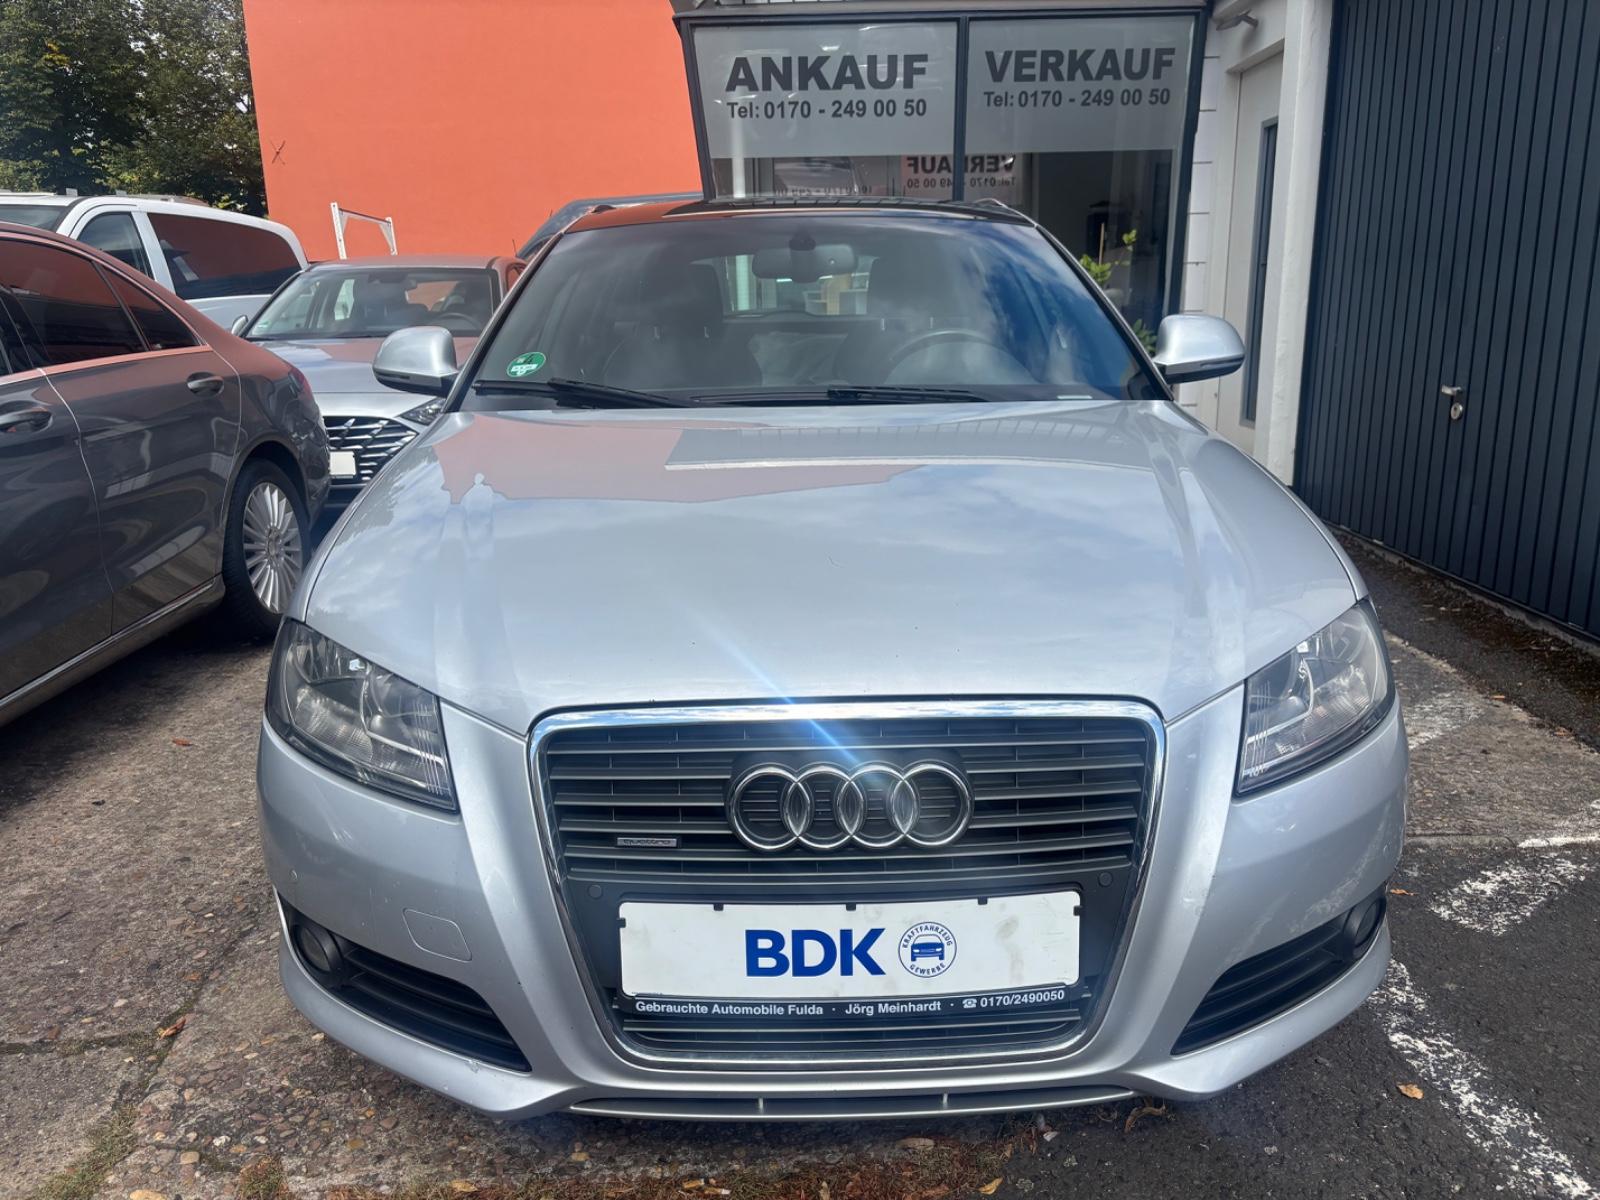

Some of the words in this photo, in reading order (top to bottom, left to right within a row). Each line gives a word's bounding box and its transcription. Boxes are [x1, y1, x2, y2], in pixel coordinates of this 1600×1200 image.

[725, 54, 929, 92] ANKAUF
[985, 47, 1176, 82] VERKAUF
[727, 102, 760, 118] Tel:
[763, 101, 811, 119] 0170
[831, 100, 867, 118] 249
[873, 99, 897, 117] 00
[903, 98, 927, 116] 50
[984, 91, 1014, 107] Tel:
[1018, 90, 1063, 107] 0170
[1080, 89, 1114, 107] 249
[1120, 89, 1143, 106] 00
[1148, 88, 1171, 105] 50
[902, 925, 953, 949] KRAFTFAHRZEUG
[745, 928, 886, 977] BDK
[910, 962, 946, 975] GEWERBE
[635, 1001, 708, 1014] Gebrauchte
[712, 1003, 785, 1015] Automobile
[788, 1004, 824, 1016] Fulda
[845, 1003, 874, 1016] Jörg
[878, 1001, 942, 1014] Meinhardt
[980, 989, 1065, 1008] 0170/2490050
